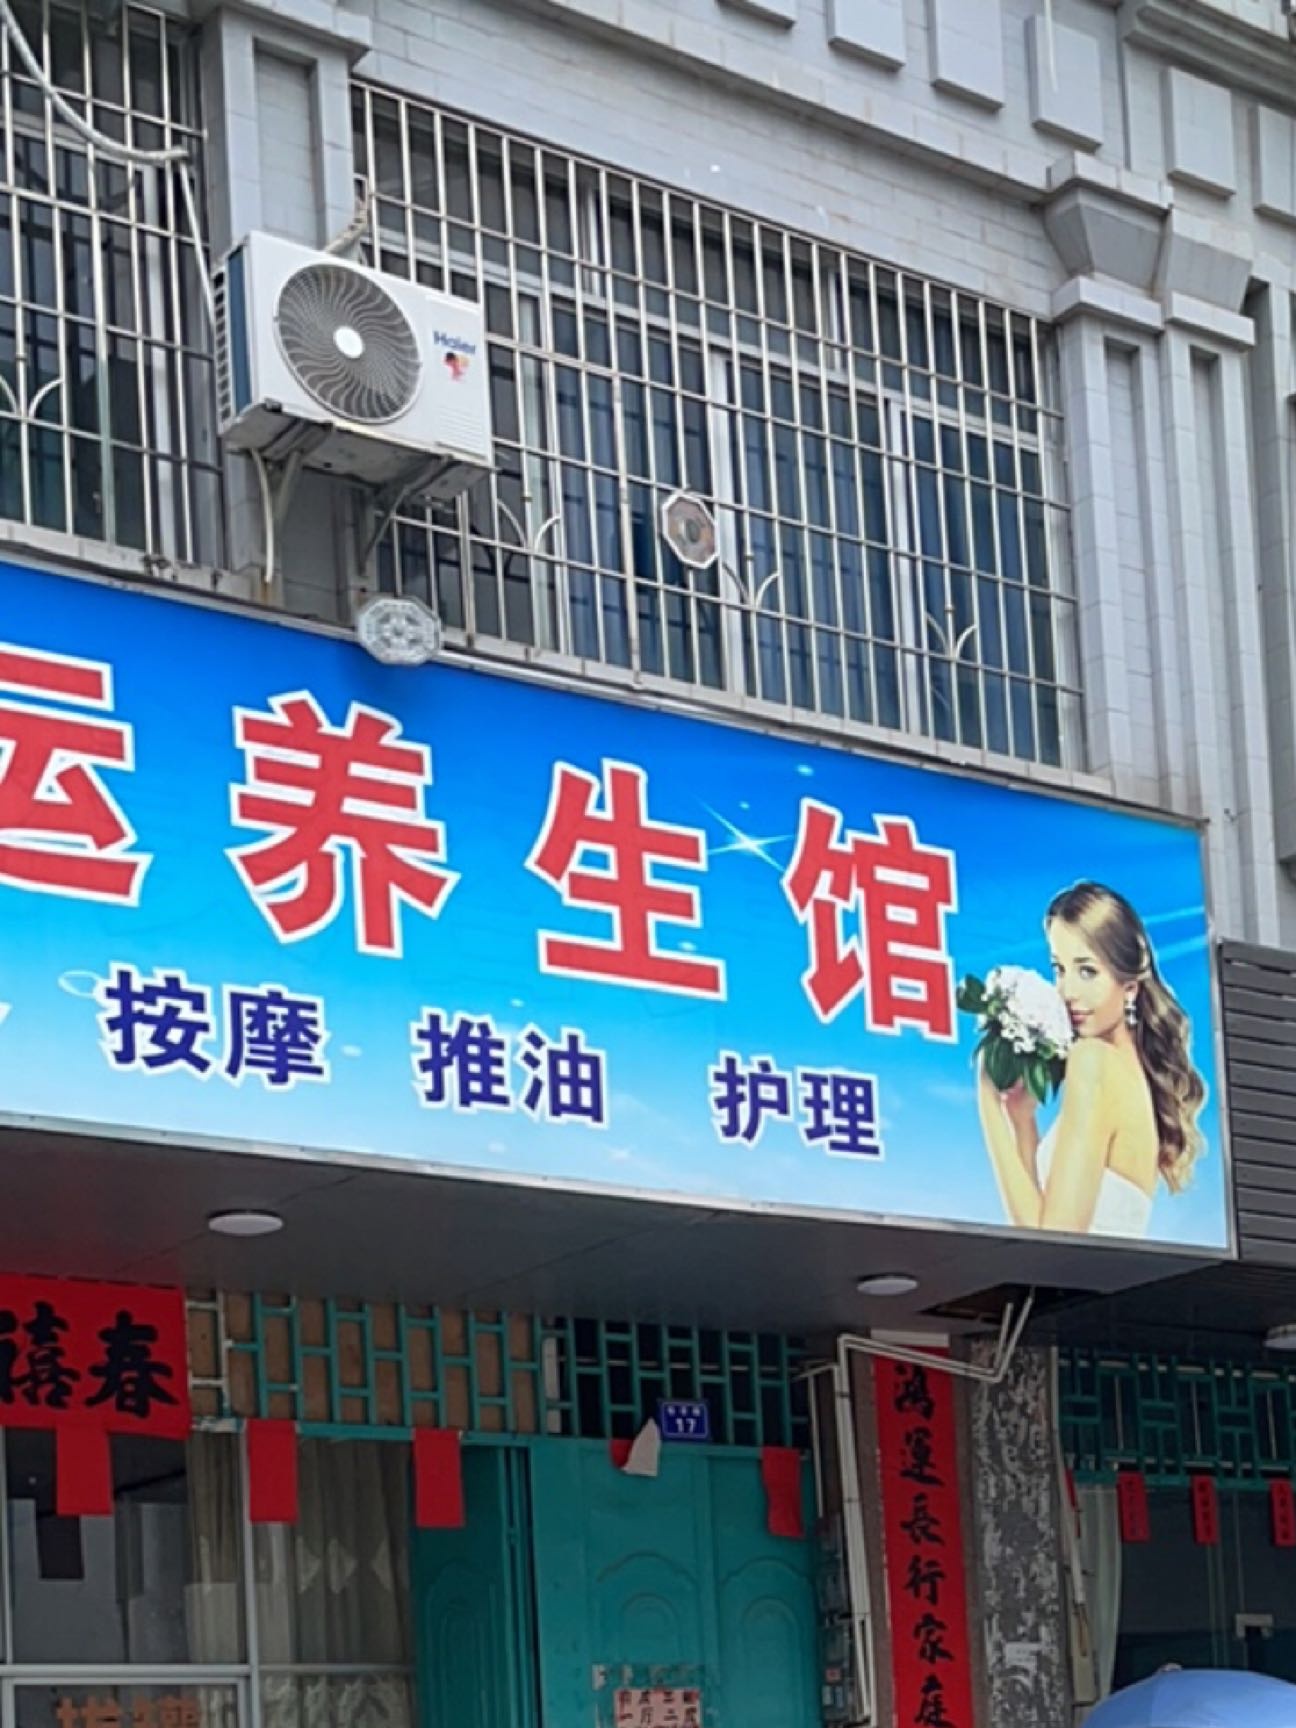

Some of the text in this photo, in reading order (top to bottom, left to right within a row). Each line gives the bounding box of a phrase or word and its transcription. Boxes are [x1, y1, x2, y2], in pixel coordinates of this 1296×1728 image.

[432, 330, 477, 354] Haier
[101, 966, 883, 1158] 按摩 推油 护理
[675, 1417, 697, 1433] 17
